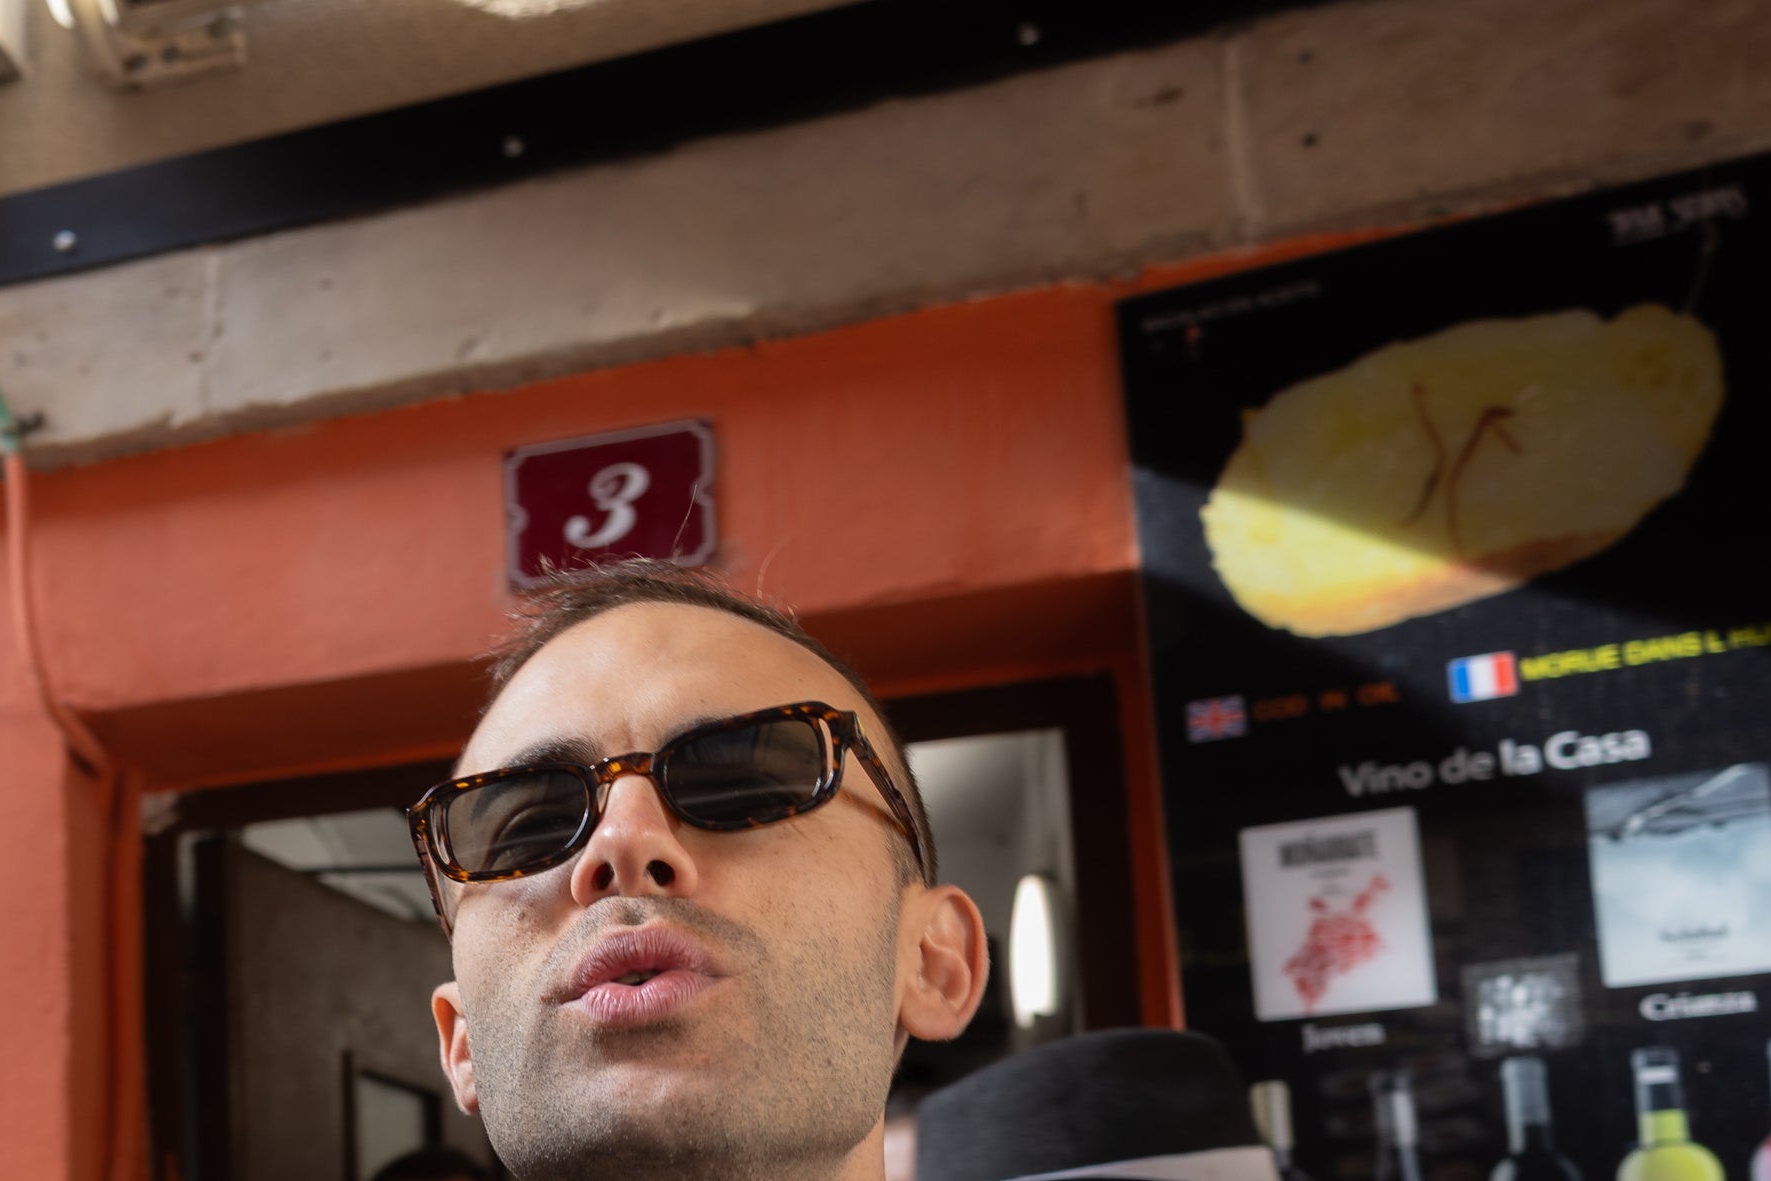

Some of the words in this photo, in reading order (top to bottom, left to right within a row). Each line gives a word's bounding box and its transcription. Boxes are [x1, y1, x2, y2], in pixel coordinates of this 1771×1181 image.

[563, 461, 651, 549] 3
[1519, 643, 1621, 682] MORUE
[1622, 631, 1702, 666] DANS
[1336, 759, 1435, 798] Vino
[1437, 744, 1496, 784] de
[1497, 737, 1543, 776] la
[1543, 729, 1652, 770] Casa
